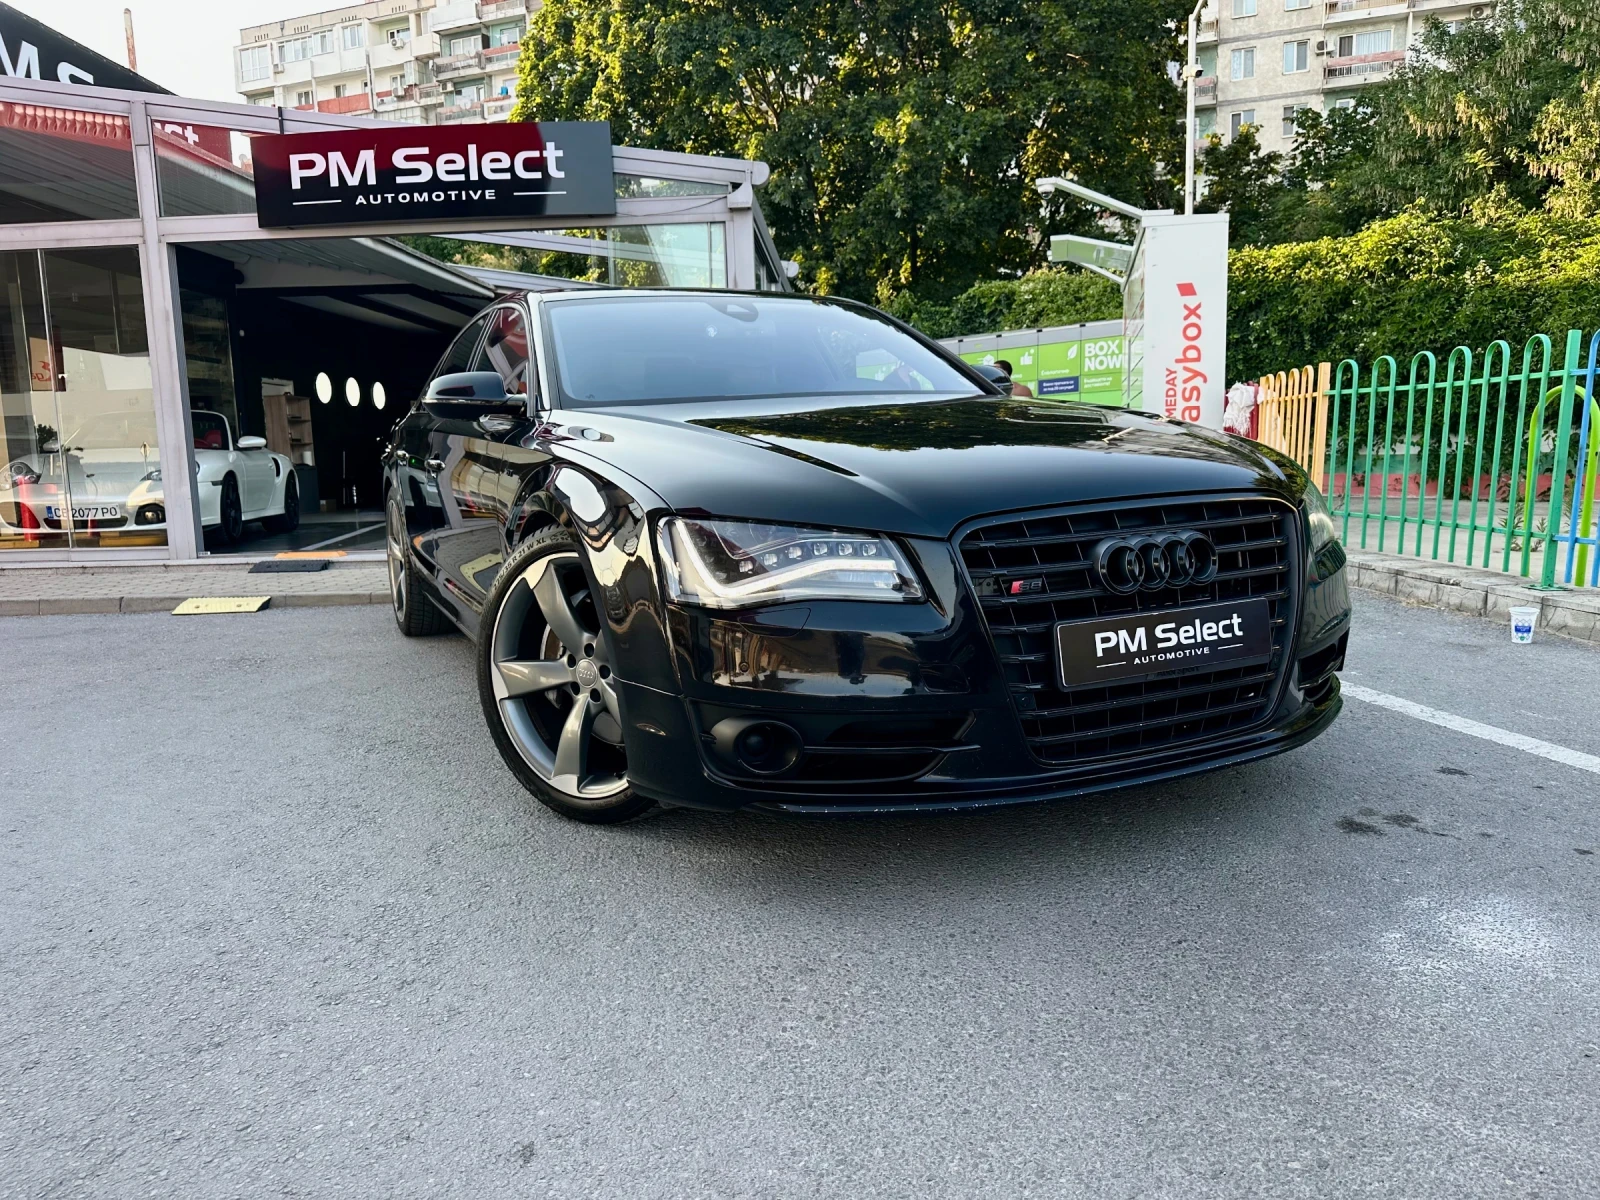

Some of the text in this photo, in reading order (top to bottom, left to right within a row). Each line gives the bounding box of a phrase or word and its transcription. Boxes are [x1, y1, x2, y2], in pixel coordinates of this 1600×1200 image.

[289, 141, 565, 190] PM Select
[355, 189, 497, 206] AUTOMOTIVE
[1084, 339, 1120, 357] BOX
[1084, 354, 1123, 372] NOW
[71, 507, 99, 519] 2077
[518, 549, 526, 557] 21
[526, 542, 534, 550] W
[536, 537, 547, 546] XL
[1094, 613, 1244, 658] PM Select
[1133, 647, 1210, 665] AUTOMOTIVE
